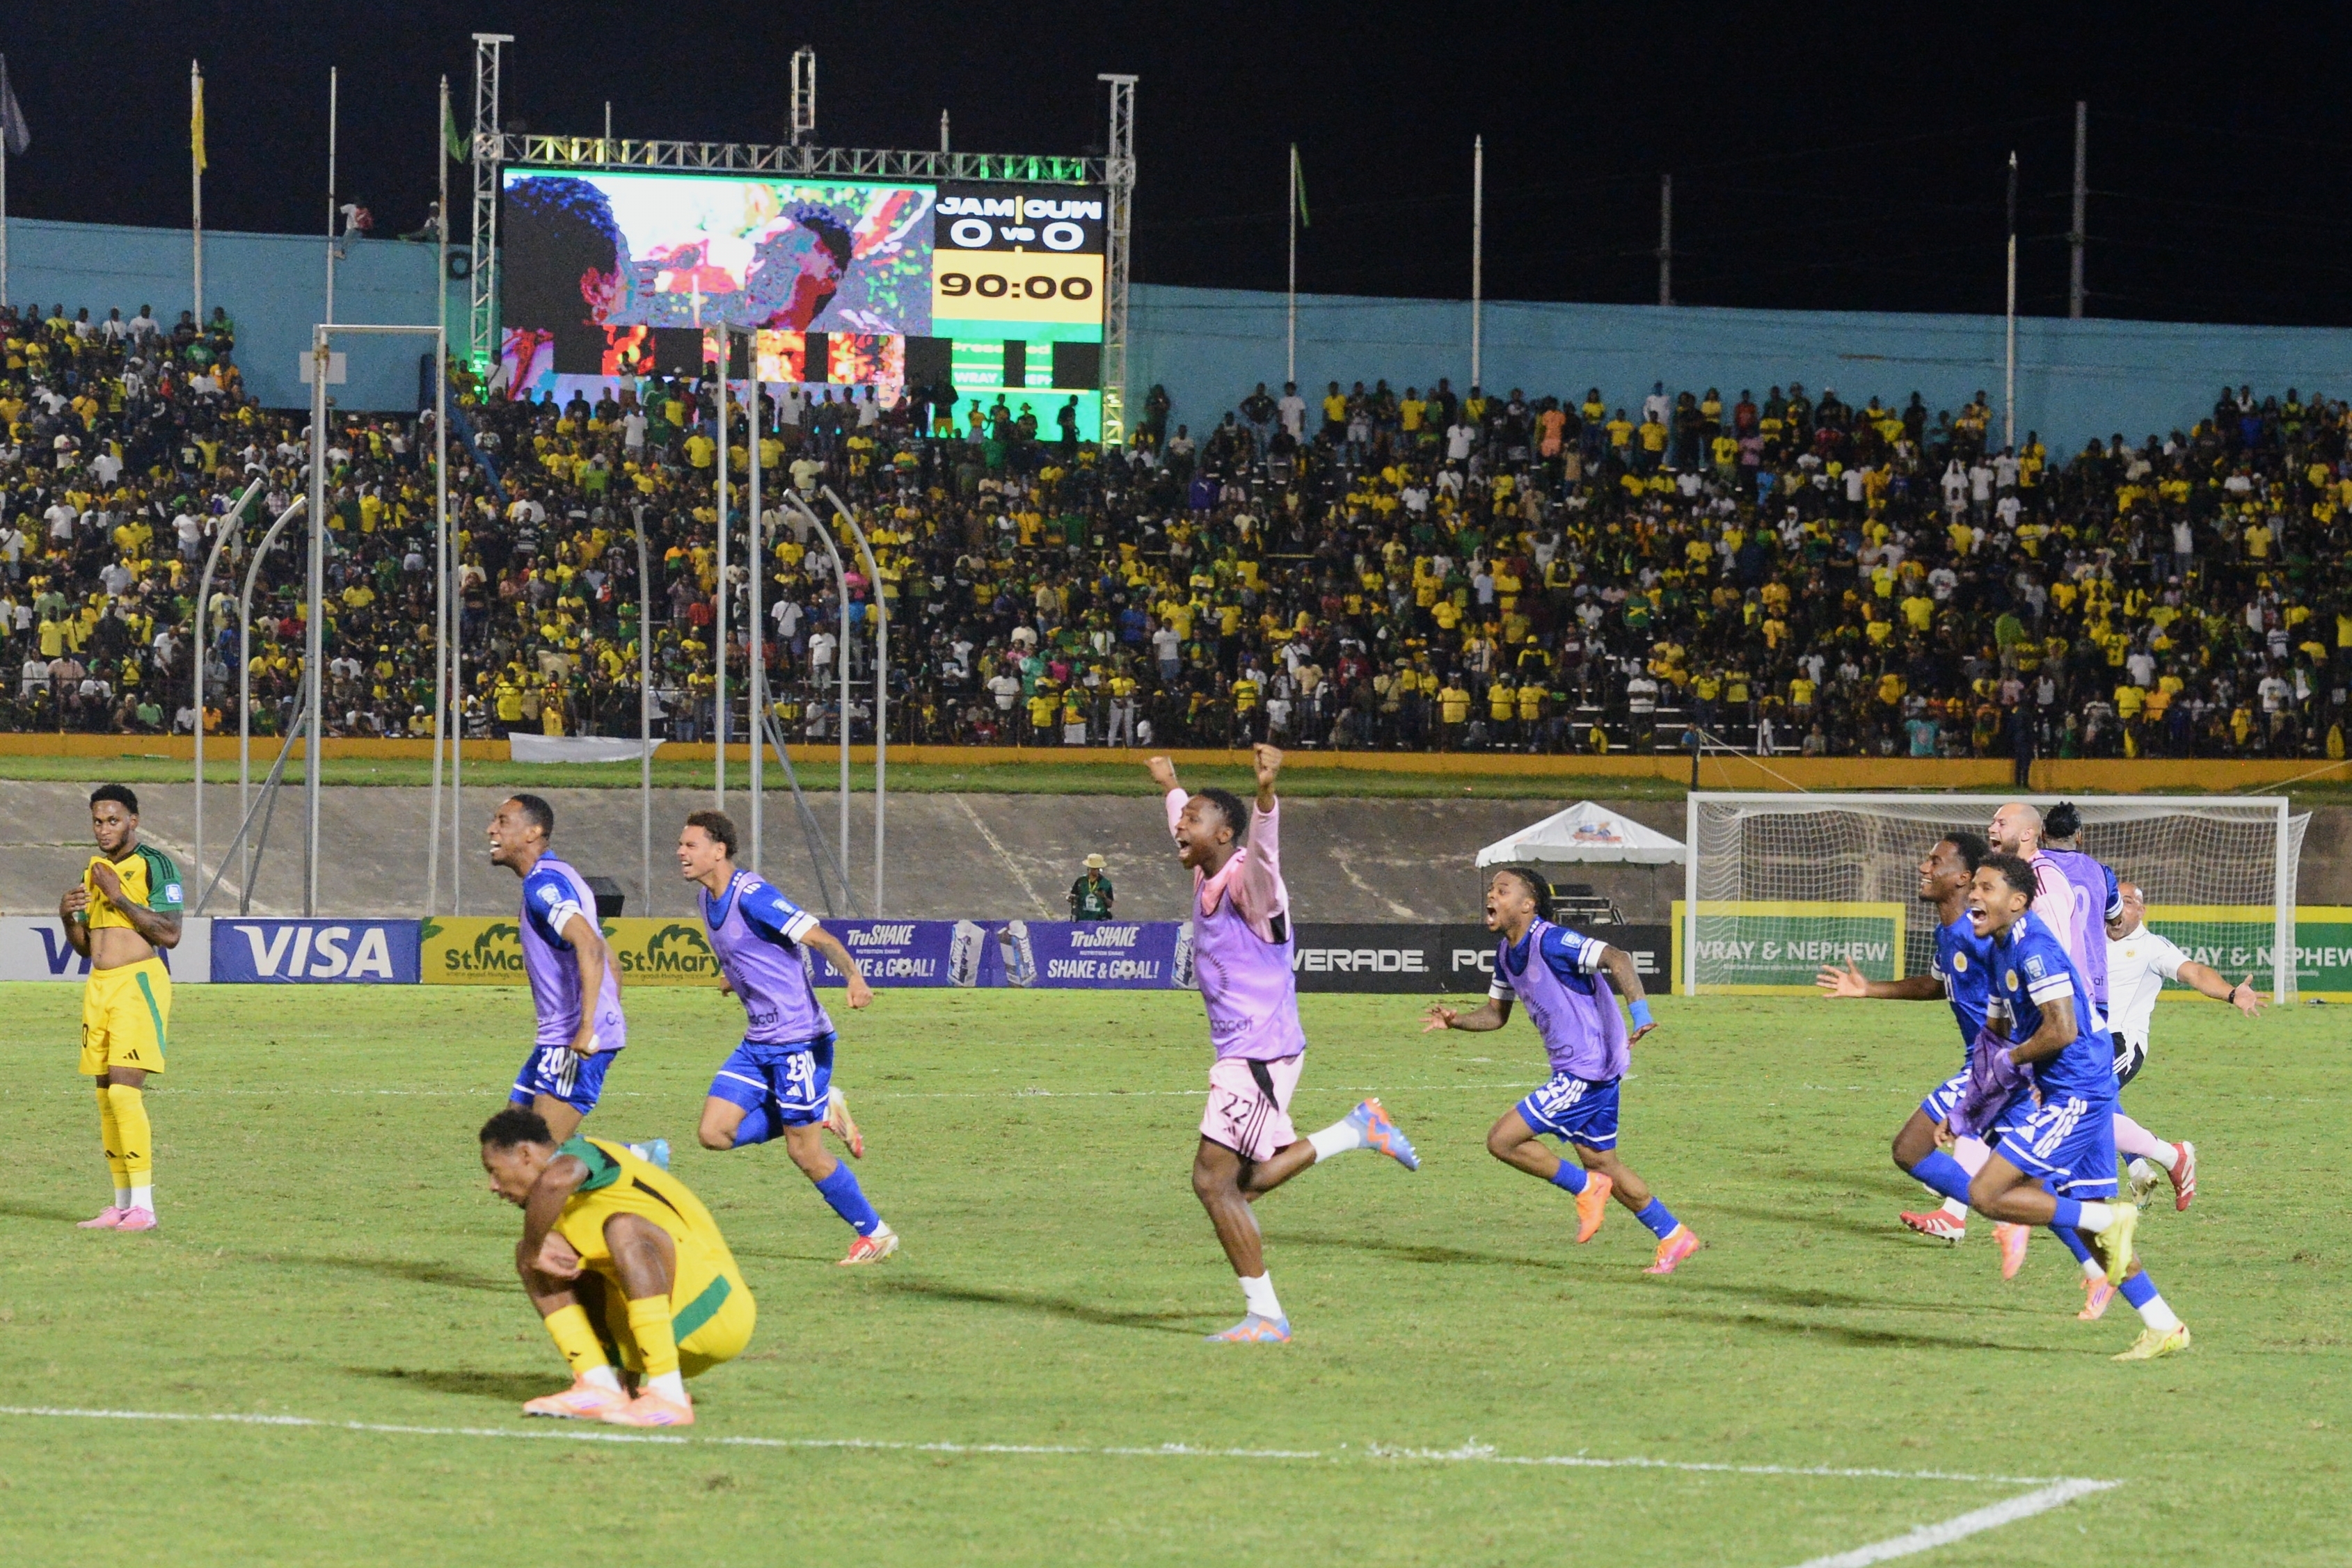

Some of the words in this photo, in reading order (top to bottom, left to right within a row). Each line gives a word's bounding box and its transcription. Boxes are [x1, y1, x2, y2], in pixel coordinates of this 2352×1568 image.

[936, 197, 1015, 216] JAM
[1024, 199, 1102, 219] CUW
[939, 273, 1092, 300] 90:00
[848, 925, 916, 946] TruSHAKE
[1071, 926, 1140, 947] TruSHAKE
[234, 926, 393, 977] VISA
[445, 949, 523, 970] St.Ma
[1762, 941, 1781, 960] &
[1788, 942, 1888, 961] NEPHEW
[2230, 947, 2251, 966] &
[874, 961, 884, 977] &
[1047, 959, 1097, 979] SHAKE
[1097, 963, 1107, 979] &
[1220, 1091, 1253, 1126] 22
